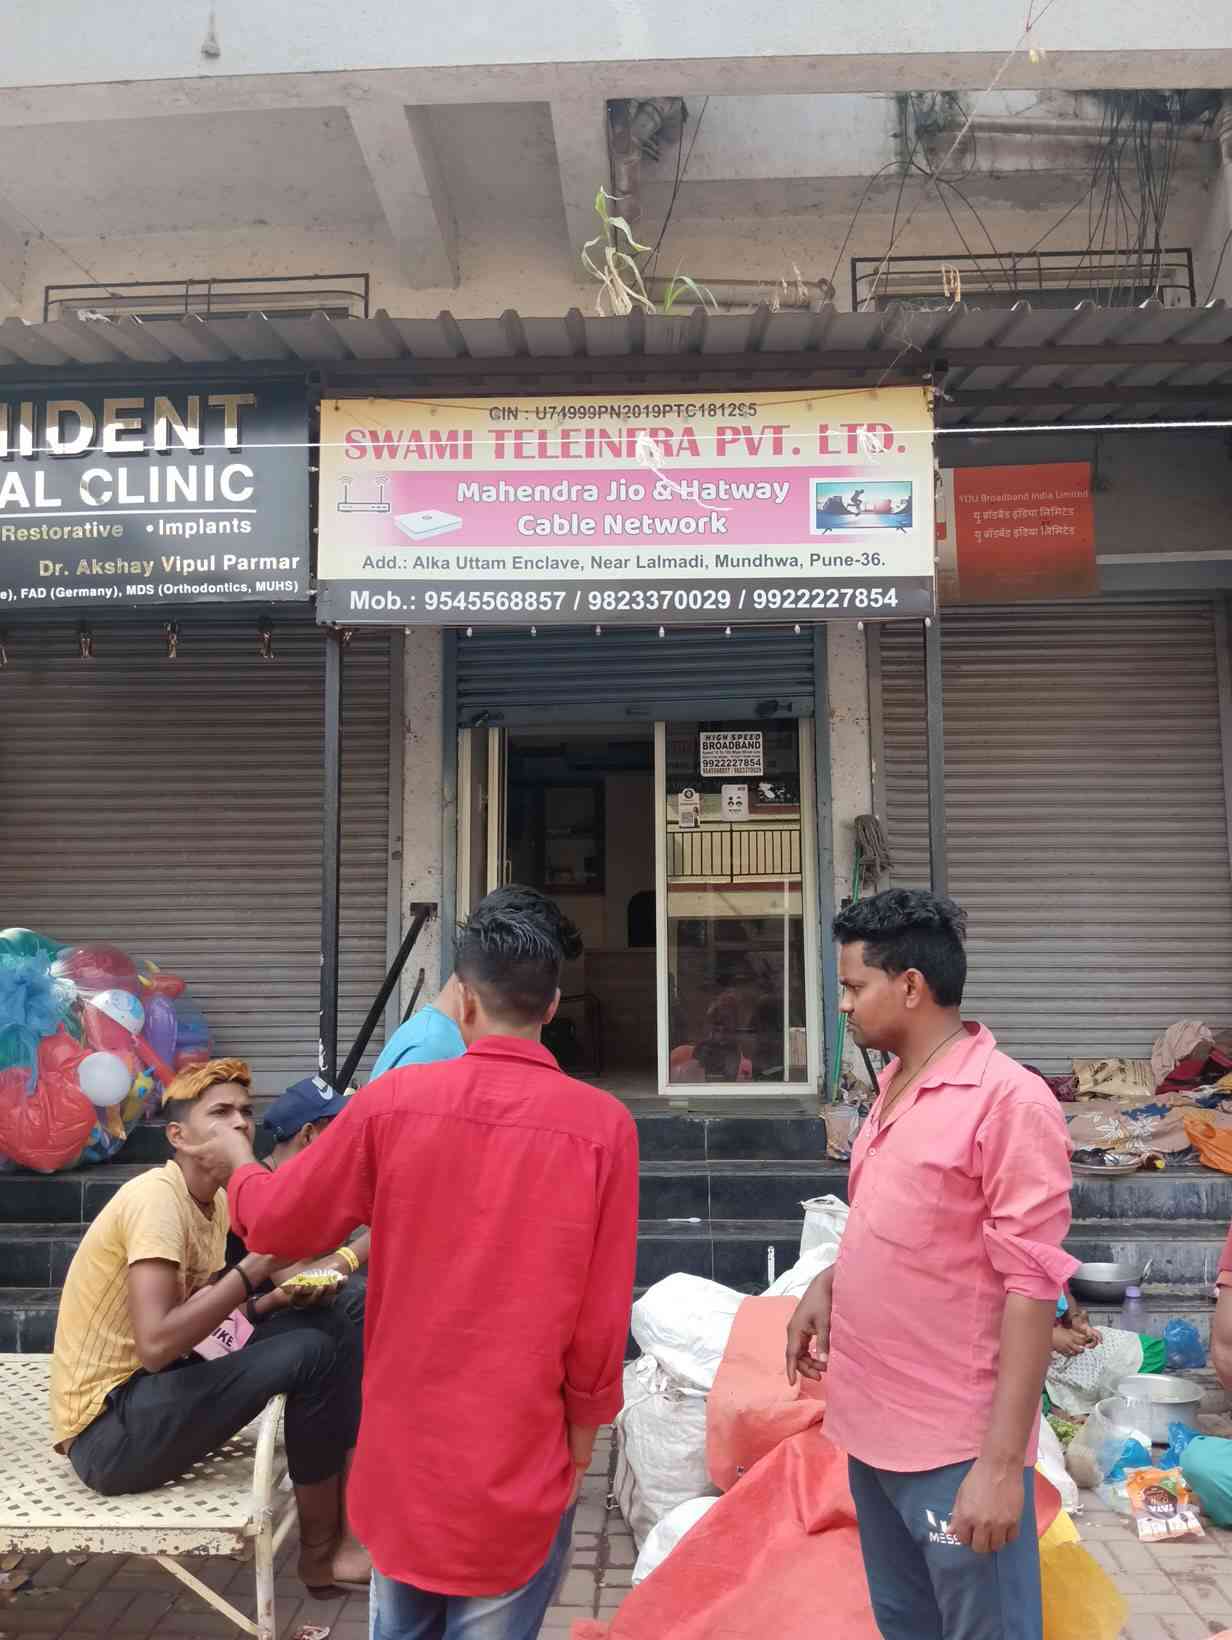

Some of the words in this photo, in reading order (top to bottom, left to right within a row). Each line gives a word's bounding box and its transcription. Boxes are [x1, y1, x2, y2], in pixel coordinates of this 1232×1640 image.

[489, 406, 519, 421] CIN
[345, 428, 473, 460] SWAMI
[716, 424, 801, 457] PVT.
[819, 422, 906, 455] LTD.
[80, 463, 254, 506] CLINIC
[457, 481, 598, 502] Mahendra
[606, 479, 645, 502] Jio
[652, 480, 680, 501] &
[681, 479, 790, 504] Hatway
[1, 521, 124, 542] Restorative
[517, 514, 596, 536] Cable
[603, 512, 728, 536] Network
[39, 560, 69, 577] Dr.
[76, 557, 154, 578] Akshay
[161, 555, 216, 573] Vipul
[223, 554, 300, 571] Parmar
[362, 555, 407, 570] Add.:
[413, 555, 450, 570] Alka
[456, 555, 506, 570] Uttam
[512, 555, 584, 573] Enclave,
[590, 554, 632, 570] Near
[636, 554, 709, 571] Lalmadi,
[715, 554, 803, 571] Mundhwa,
[810, 552, 885, 568] Pune-36.
[20, 586, 47, 599] FAD
[50, 584, 122, 600] (Germany),
[126, 583, 154, 596] MDS
[158, 579, 251, 597] (Orthodontics,
[255, 579, 299, 595] MUHS)
[350, 590, 416, 610] Mob.:
[424, 590, 566, 610] 9545568857
[573, 590, 582, 610] /
[588, 590, 730, 610] 9823370029
[738, 589, 747, 609] /
[753, 588, 898, 609] 9922227854
[702, 741, 761, 750] BROADBAND
[702, 759, 761, 768] 9922227854
